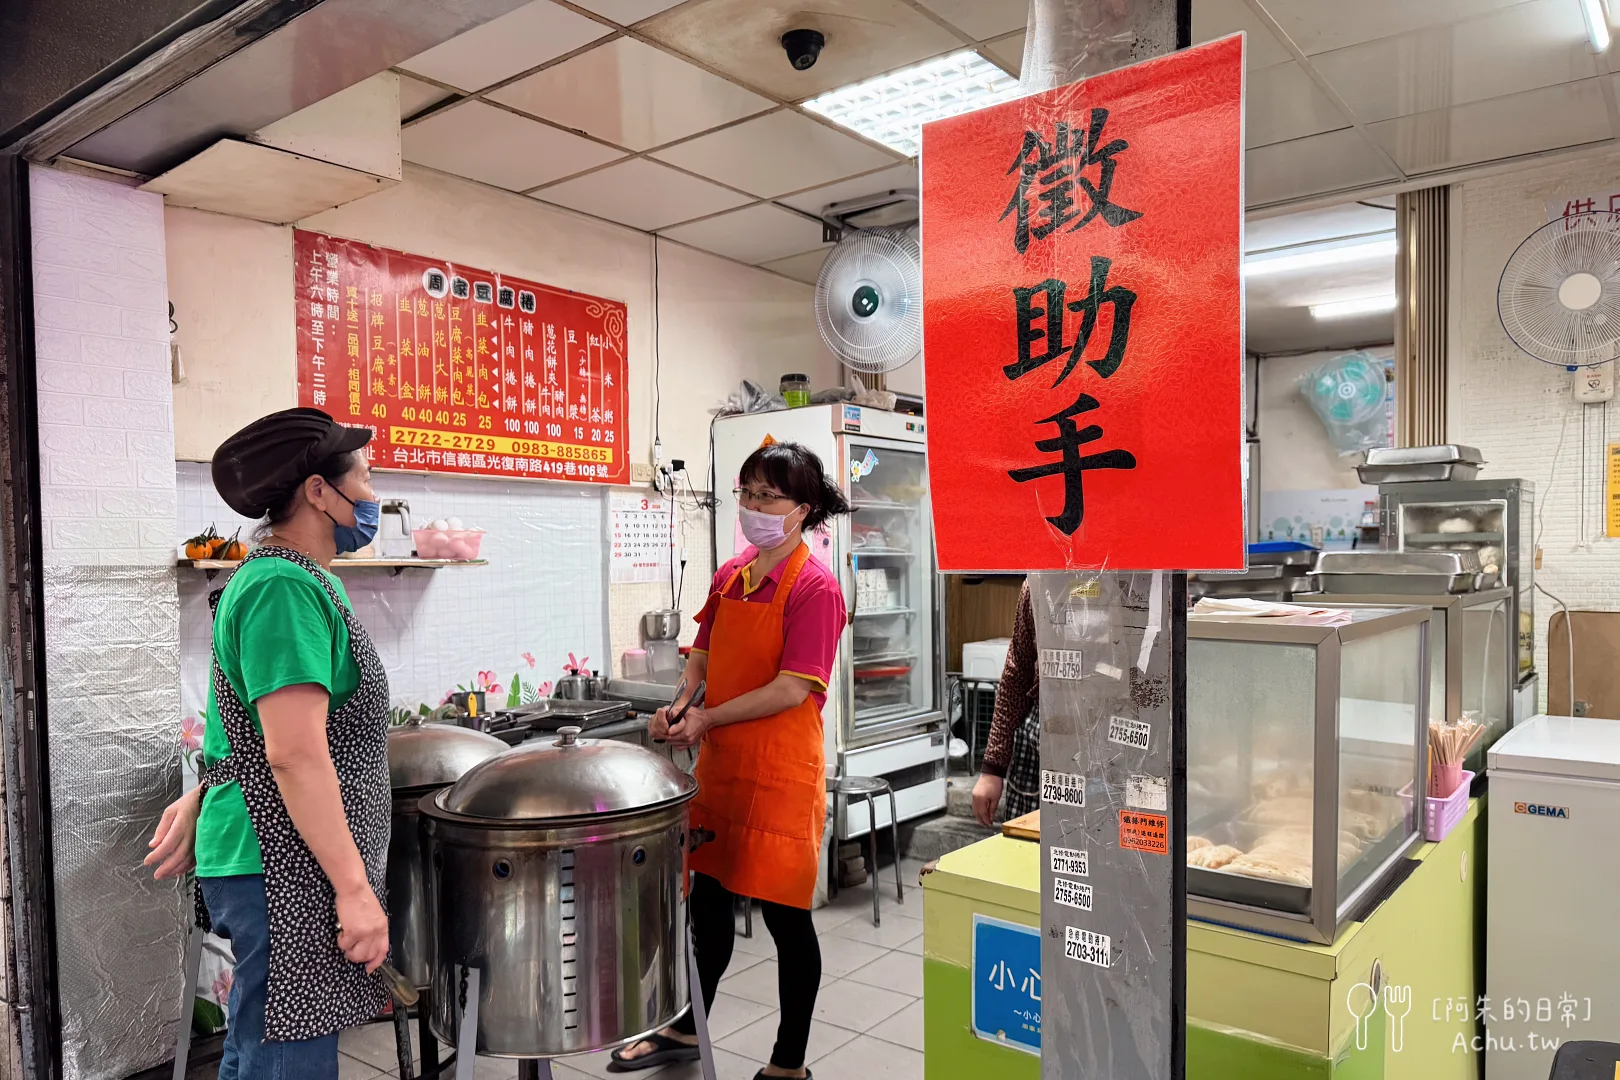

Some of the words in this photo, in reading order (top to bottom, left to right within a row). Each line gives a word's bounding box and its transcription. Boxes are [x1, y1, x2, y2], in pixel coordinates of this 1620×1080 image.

[426, 269, 536, 313] 周家豆腐捲
[309, 249, 327, 405] 上午六時至下午三時
[998, 107, 1143, 536] 徵助手
[371, 290, 387, 396] 招牌豆腐捲
[399, 298, 414, 399] 韭菜盒
[476, 311, 490, 408] 韭菜肉包
[504, 315, 517, 413] 牛肉捲餅
[589, 335, 602, 422] 紅茶
[372, 403, 387, 418] 40
[402, 407, 416, 421] 40
[419, 409, 433, 423] 40
[436, 411, 450, 425] 40
[453, 412, 466, 427] 25
[479, 415, 491, 429] 25
[504, 418, 520, 432] 100
[524, 420, 539, 435] 100
[546, 423, 561, 437] 100
[574, 427, 583, 439] 15
[592, 429, 600, 442] 20
[605, 430, 614, 443] 25
[393, 446, 609, 478] 台北市信義區光復南路419巷106號
[395, 430, 495, 450] 2722-2729
[512, 442, 607, 460] 0983-885865
[641, 499, 649, 510] 3
[1042, 662, 1080, 678] 2707-8759
[1109, 725, 1148, 747] 2755-6500
[1043, 784, 1083, 805] 2739-8600
[1527, 804, 1566, 818] GEMA
[1053, 857, 1087, 874] 2771-9353
[1055, 887, 1091, 908] 2755-6500
